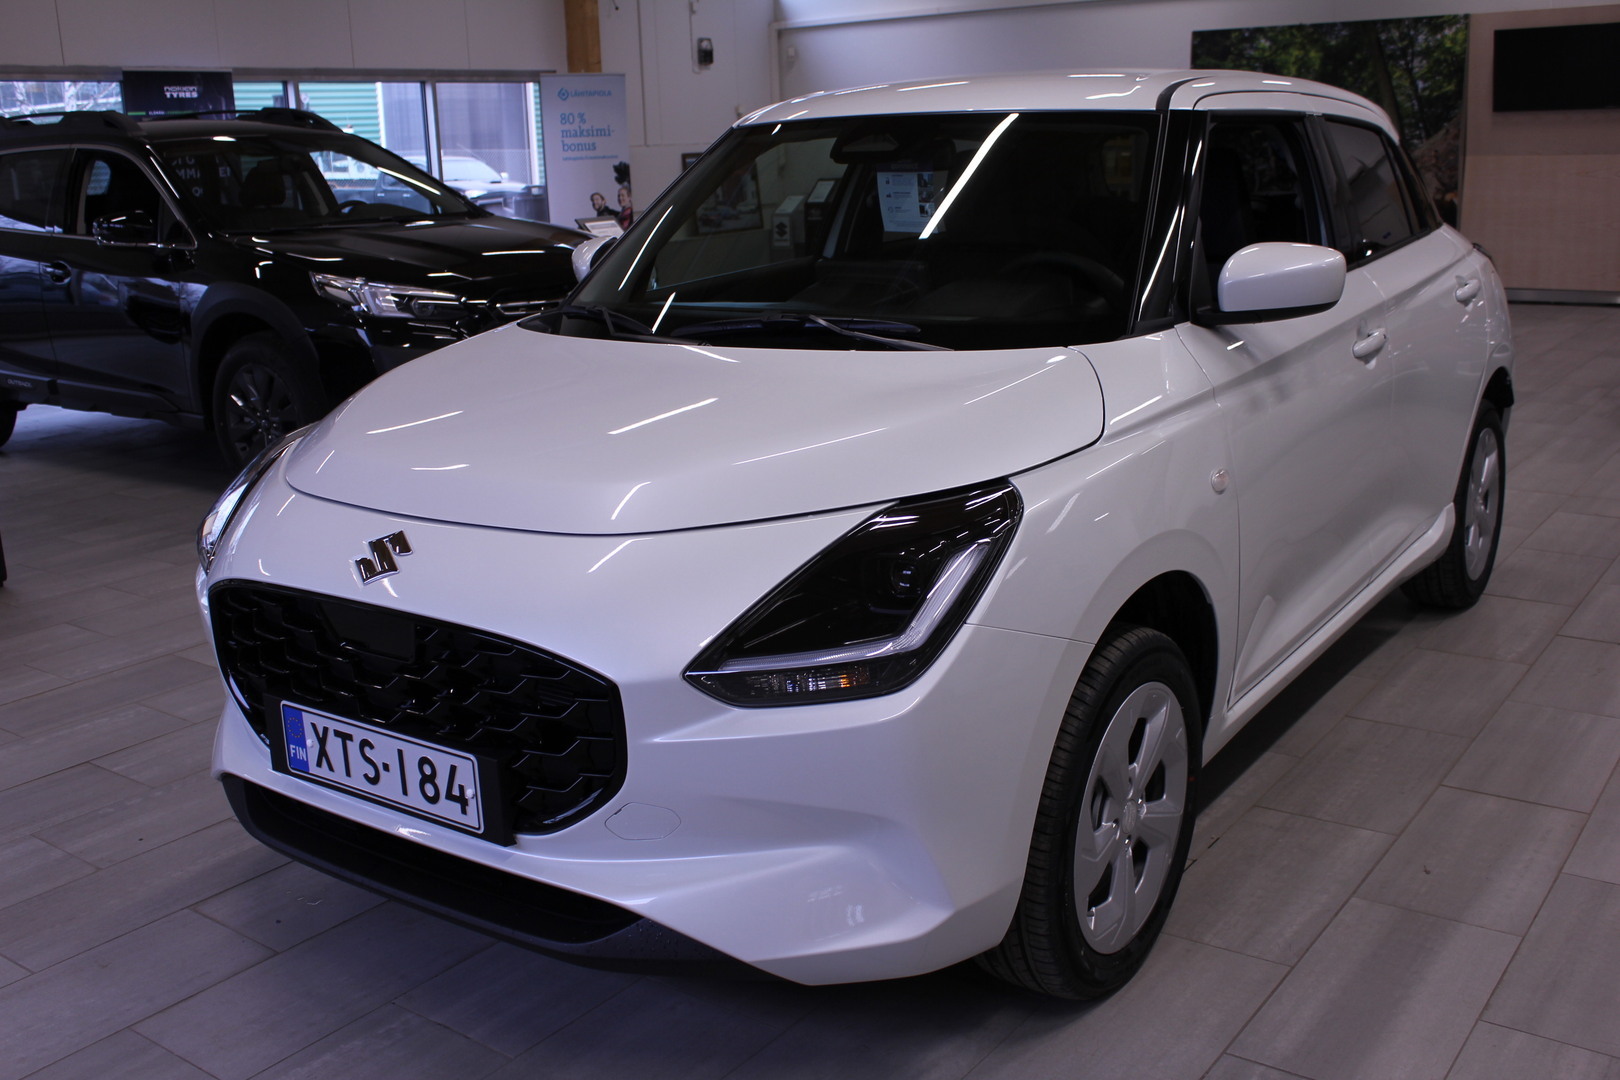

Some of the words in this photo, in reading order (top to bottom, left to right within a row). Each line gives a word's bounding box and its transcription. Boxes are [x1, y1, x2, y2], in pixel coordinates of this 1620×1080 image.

[571, 89, 611, 97] LÄHITAPIOLA
[560, 113, 575, 125] 80
[577, 112, 586, 124] %
[561, 125, 614, 138] maksimi-
[562, 140, 596, 151] bonus
[289, 744, 307, 761] FIN
[310, 721, 469, 815] XTS-184
